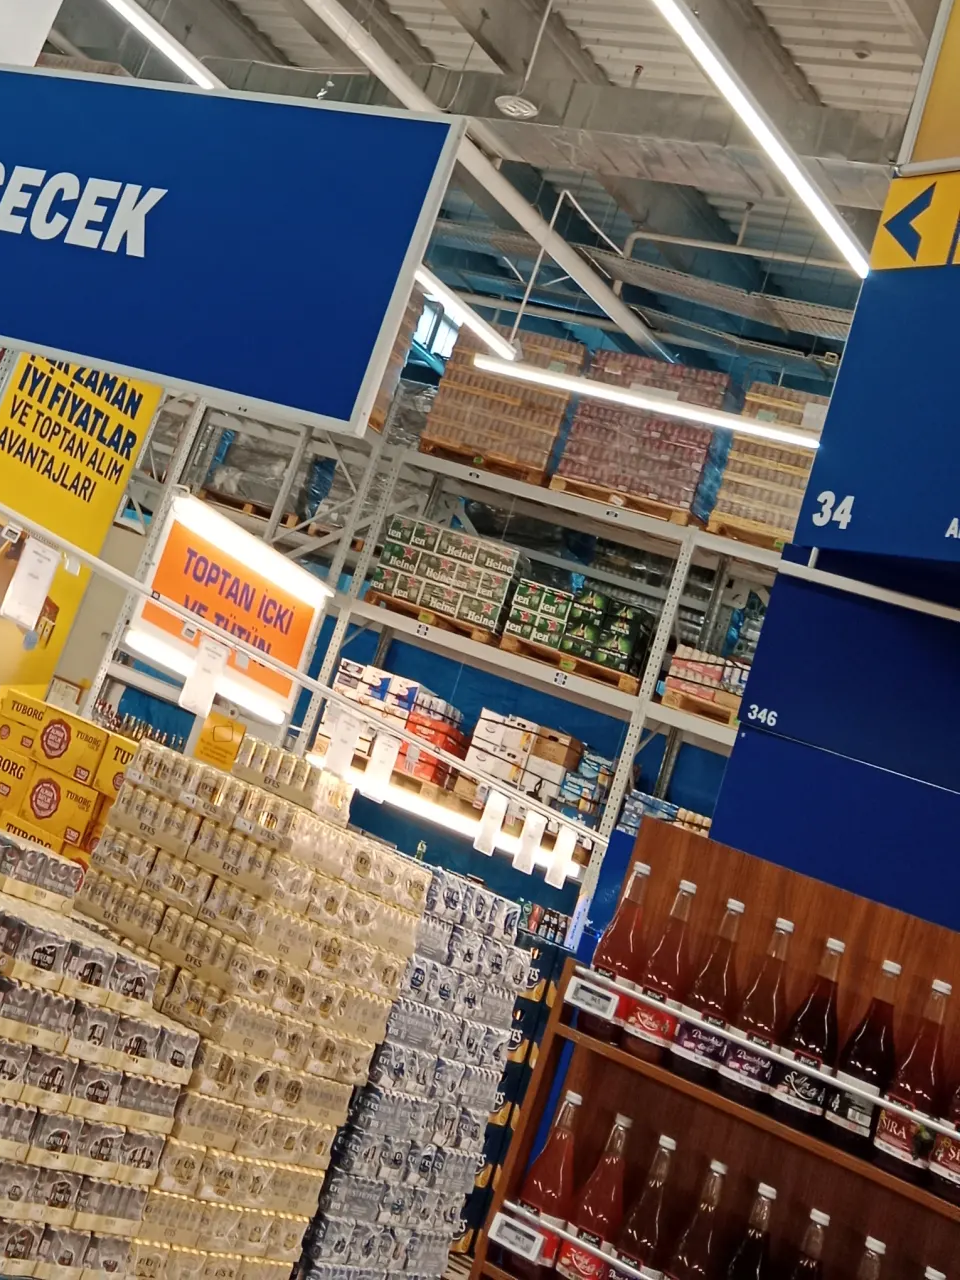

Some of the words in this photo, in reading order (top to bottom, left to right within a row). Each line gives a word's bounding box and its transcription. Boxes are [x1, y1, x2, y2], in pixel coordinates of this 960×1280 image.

[18, 355, 55, 404] İYİ
[47, 381, 137, 461] FİYATLAR
[72, 366, 143, 420] ZAMAN
[10, 394, 33, 427] VE
[31, 409, 90, 463] TOPTAN
[85, 447, 125, 485] ALIM
[812, 490, 855, 530] 34
[183, 547, 256, 613] TOPTAN
[257, 588, 296, 635] İÇKİ
[11, 700, 44, 721] TUBORG
[747, 703, 779, 727] 346
[140, 823, 156, 835] EFES
[222, 862, 239, 875] EFES
[185, 955, 202, 967] EFES
